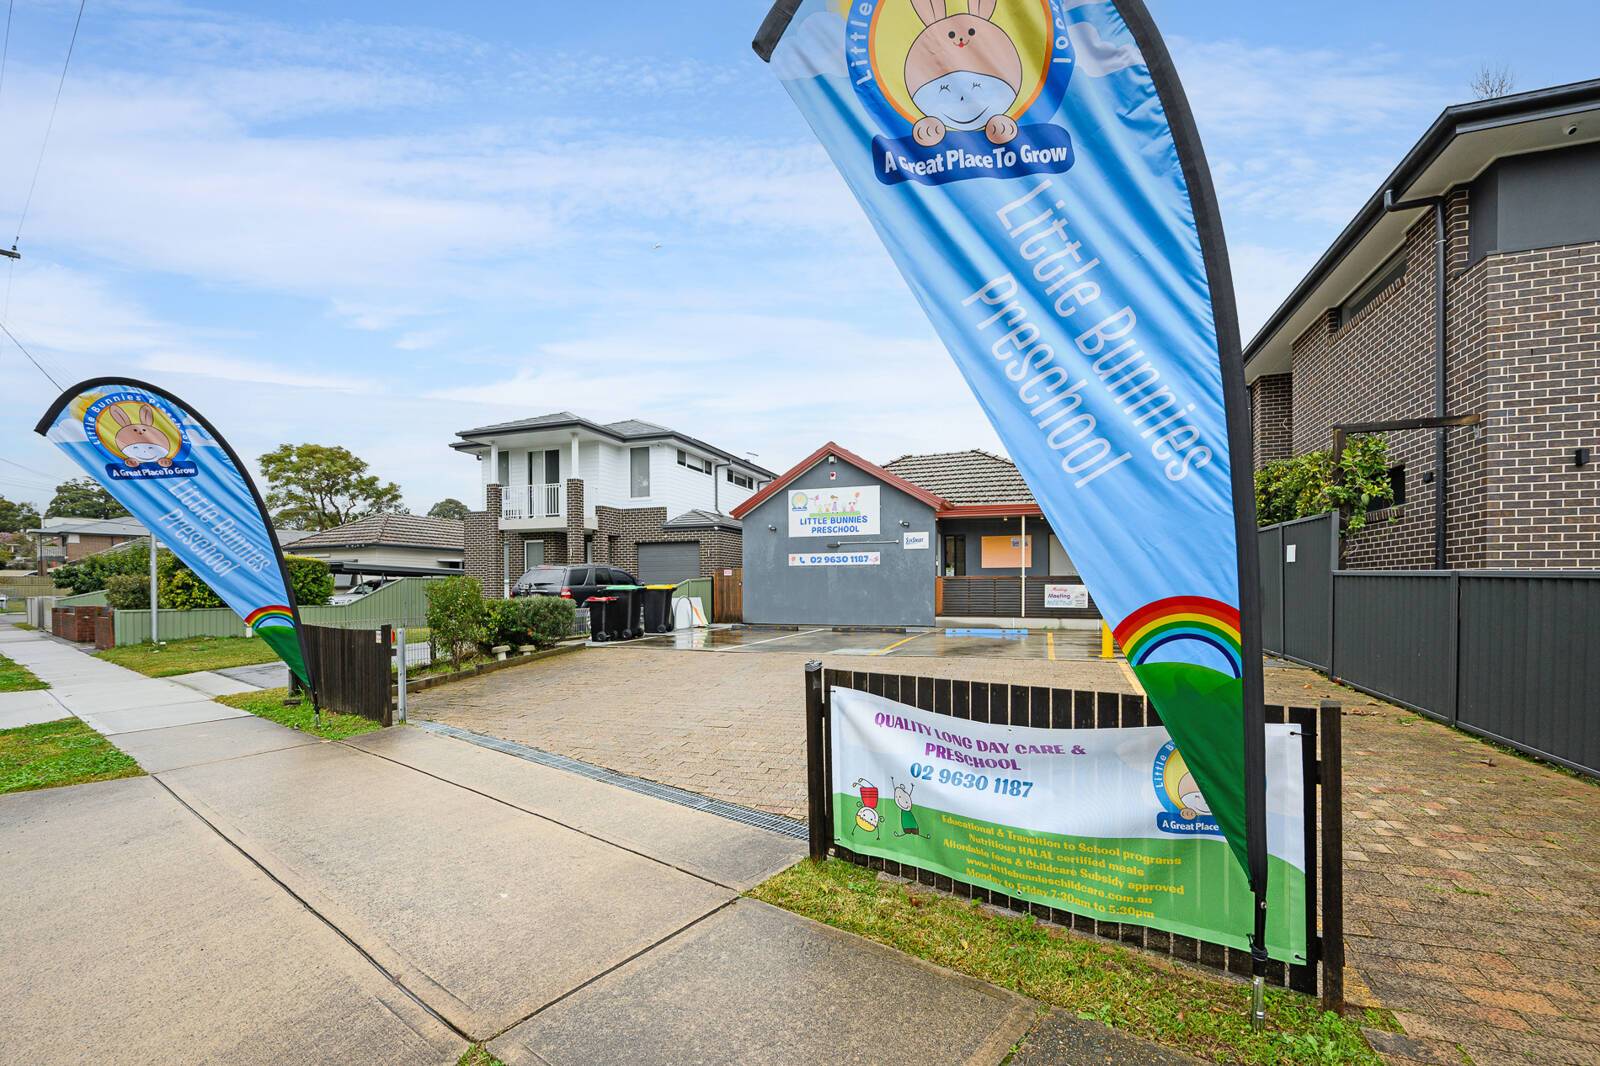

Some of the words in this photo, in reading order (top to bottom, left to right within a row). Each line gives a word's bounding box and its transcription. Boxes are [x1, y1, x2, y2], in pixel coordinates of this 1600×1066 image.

[850, 2, 873, 87] Little
[885, 151, 897, 173] A
[898, 153, 945, 176] Great
[946, 148, 994, 170] Place
[993, 146, 1016, 169] To
[1020, 144, 1067, 164] Grow
[996, 178, 1101, 318] Little
[1074, 305, 1213, 482] Bunnies
[962, 272, 1133, 489] Preschool
[91, 393, 141, 414] Bunnies
[112, 469, 120, 477] A
[120, 469, 140, 477] Great
[141, 468, 164, 476] Place
[163, 467, 174, 475] To
[169, 479, 221, 523] Little
[211, 517, 271, 573] Bunnies
[800, 516, 828, 526] LITTLE
[830, 515, 868, 525] BUNNIES
[811, 525, 860, 534] PRESCHOOL
[159, 507, 240, 577] Preschool
[810, 556, 823, 564] 02
[824, 555, 848, 564] 9630
[851, 555, 869, 563] 1187
[874, 711, 932, 737] QUALITY
[934, 728, 972, 749] LONG
[976, 739, 1010, 755] DAY
[1015, 744, 1066, 755] CARE
[1071, 744, 1086, 755] &
[924, 742, 1022, 771] PRESCHOOL
[1154, 754, 1167, 788] Little
[910, 762, 934, 781] 02
[938, 768, 989, 791] 9630
[994, 777, 1033, 798] 1187
[941, 814, 994, 835] Educational
[996, 828, 1005, 838] &
[1006, 830, 1061, 849] Transition
[1063, 841, 1076, 851] to
[1078, 842, 1120, 856] School
[1122, 851, 1182, 865] programs
[1162, 819, 1169, 828] A
[1170, 821, 1195, 831] Great
[1195, 822, 1220, 831] Place
[943, 838, 990, 858] Affordable
[991, 852, 1012, 865] fees
[1015, 858, 1024, 867] &
[1026, 860, 1077, 877] Childcare
[1080, 868, 1124, 889] Subsidy
[1127, 882, 1185, 896] approved
[968, 833, 1017, 853] Nutritious
[1019, 846, 1053, 860] HALAL
[1056, 855, 1106, 868] certified
[1108, 863, 1145, 877] meals
[965, 867, 1002, 885] Monday
[1004, 880, 1015, 890] to
[1017, 882, 1049, 898] Friday
[1050, 888, 1090, 909] 7:30am
[1093, 902, 1106, 912] to
